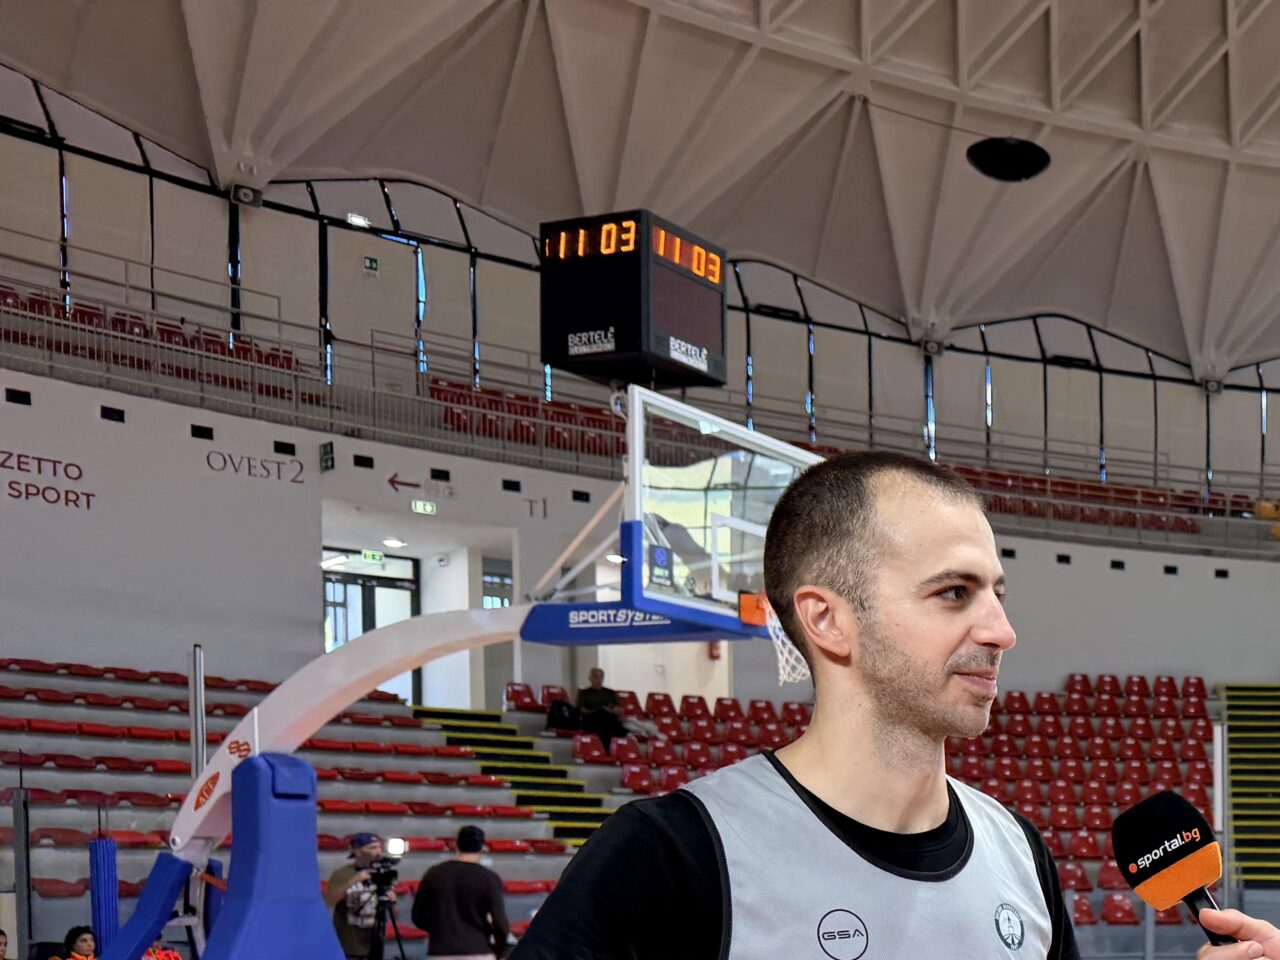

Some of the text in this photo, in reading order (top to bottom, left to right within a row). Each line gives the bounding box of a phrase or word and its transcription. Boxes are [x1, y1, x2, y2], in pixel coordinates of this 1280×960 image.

[600, 220, 636, 255] 03
[691, 245, 721, 285] 03
[8, 481, 96, 510] SPORT
[568, 608, 672, 627] SPORTSYS
[1137, 827, 1201, 869] sportal.bg
[821, 928, 865, 941] GSA
